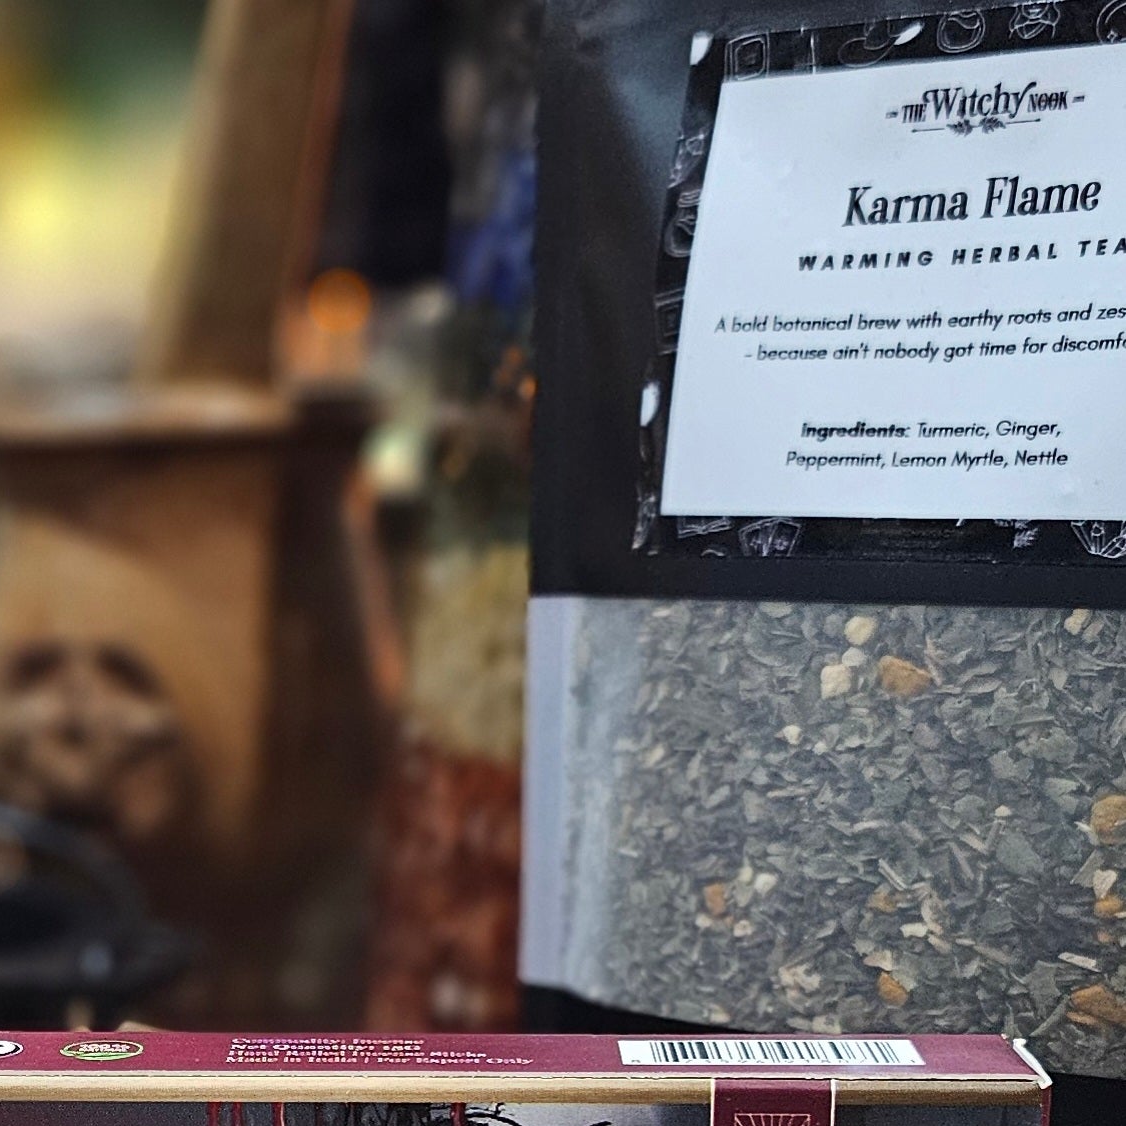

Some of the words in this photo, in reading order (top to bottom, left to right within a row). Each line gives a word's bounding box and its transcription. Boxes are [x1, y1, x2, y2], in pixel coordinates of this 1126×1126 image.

[901, 103, 927, 123] THE
[922, 81, 1037, 120] Witchy
[1028, 91, 1068, 113] NOOK
[841, 186, 969, 226] Karma
[979, 176, 1102, 219] Flame
[798, 250, 934, 271] WARMING
[951, 243, 1058, 265] HERBAL
[714, 317, 727, 333] A
[731, 315, 769, 333] bold
[773, 314, 854, 332] botanical
[857, 314, 902, 330] brew
[906, 311, 943, 329] with
[947, 308, 1004, 331] earthy
[1007, 309, 1052, 325] roots
[1056, 302, 1093, 321] and
[757, 344, 828, 361] because
[832, 342, 869, 360] ain't
[874, 341, 940, 363] nobody
[943, 344, 976, 363] got
[979, 342, 1018, 357] time
[1022, 337, 1047, 354] for
[916, 422, 991, 440] Turmeric,
[996, 420, 1062, 441] Ginger,
[786, 451, 886, 471] Peppermint,
[891, 451, 947, 468] Lemon
[950, 449, 1010, 471] Myrtle,
[1014, 448, 1069, 467] Nettle
